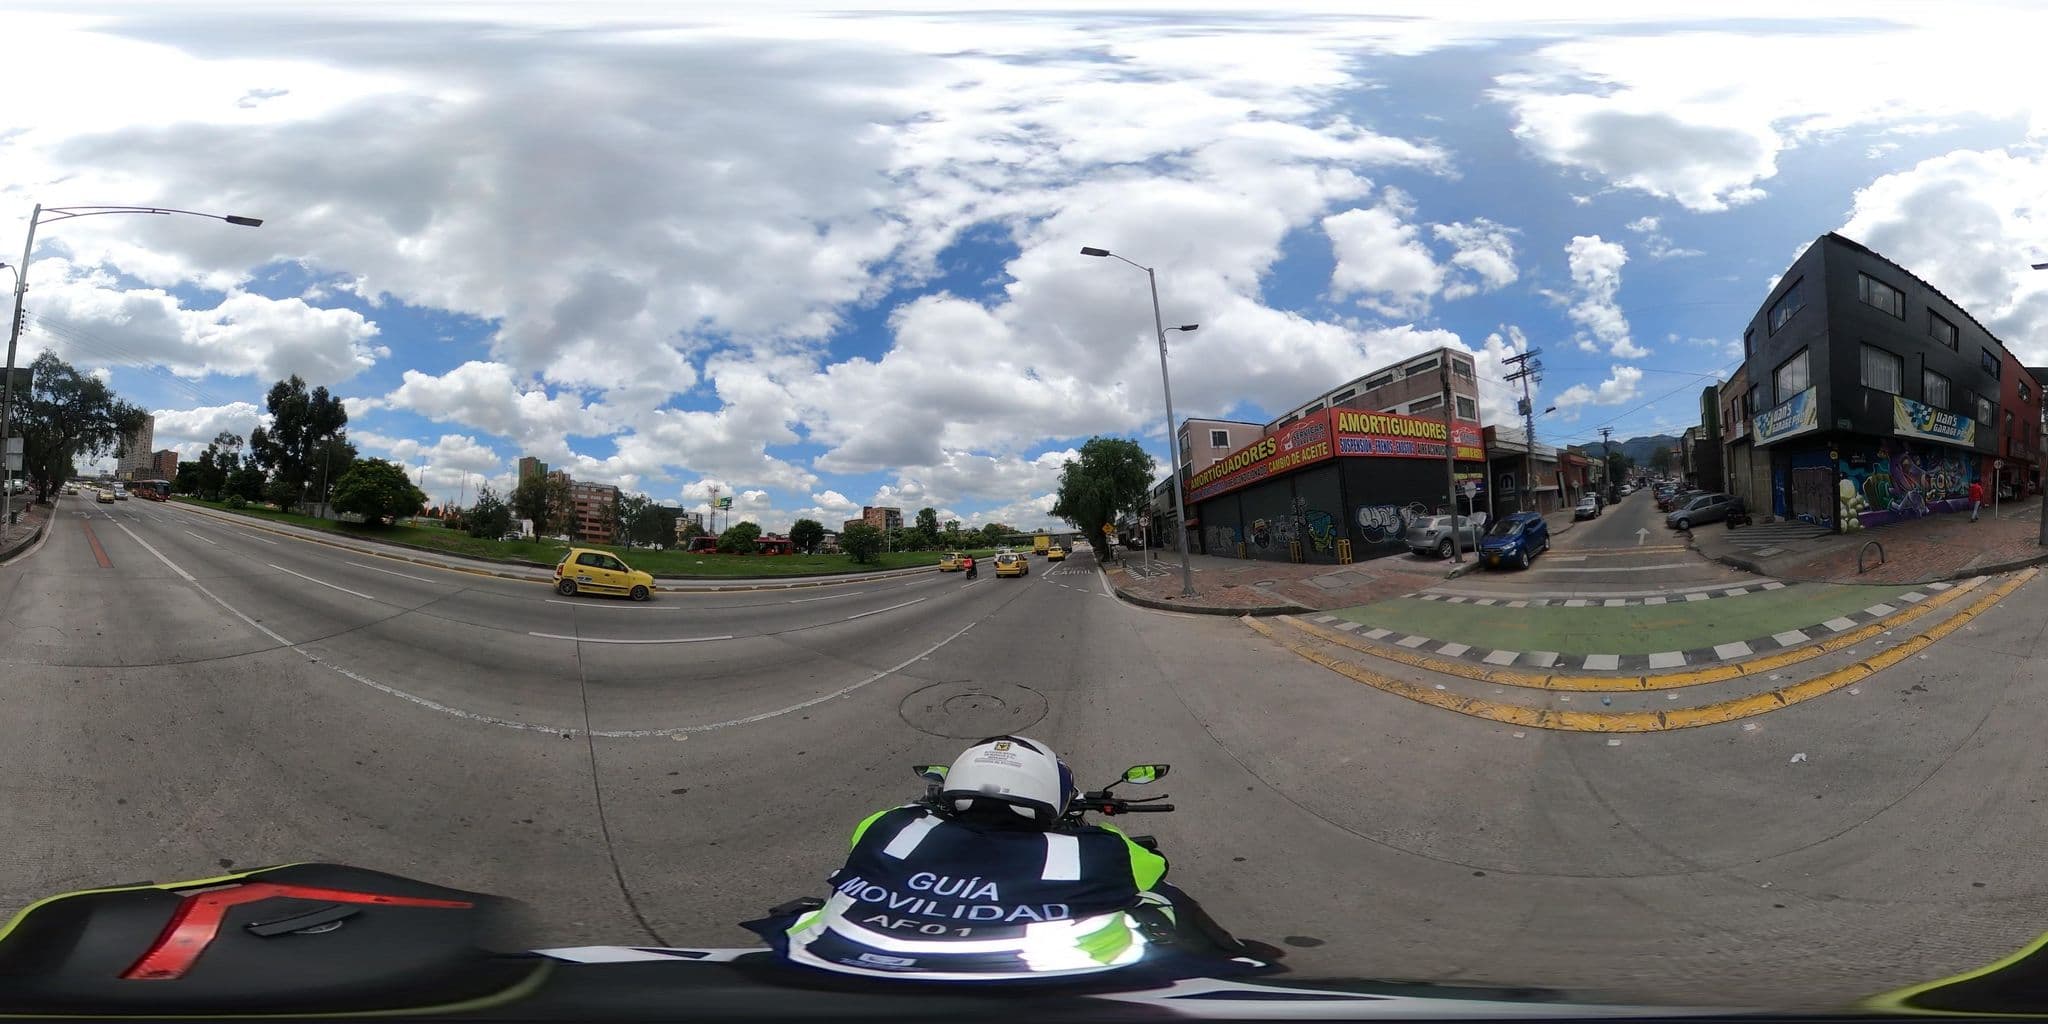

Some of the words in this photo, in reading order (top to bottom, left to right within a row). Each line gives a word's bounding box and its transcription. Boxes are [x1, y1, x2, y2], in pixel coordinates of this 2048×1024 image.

[1338, 411, 1447, 440] AMORTIGUADORES
[1190, 436, 1277, 490] AMORTIGUADORES
[1268, 455, 1291, 473] CAMBIO
[1291, 451, 1301, 465] DE
[1301, 441, 1329, 462] ACEITE
[838, 876, 1069, 922] MOVILIDAD
[907, 871, 999, 902] GUÍA
